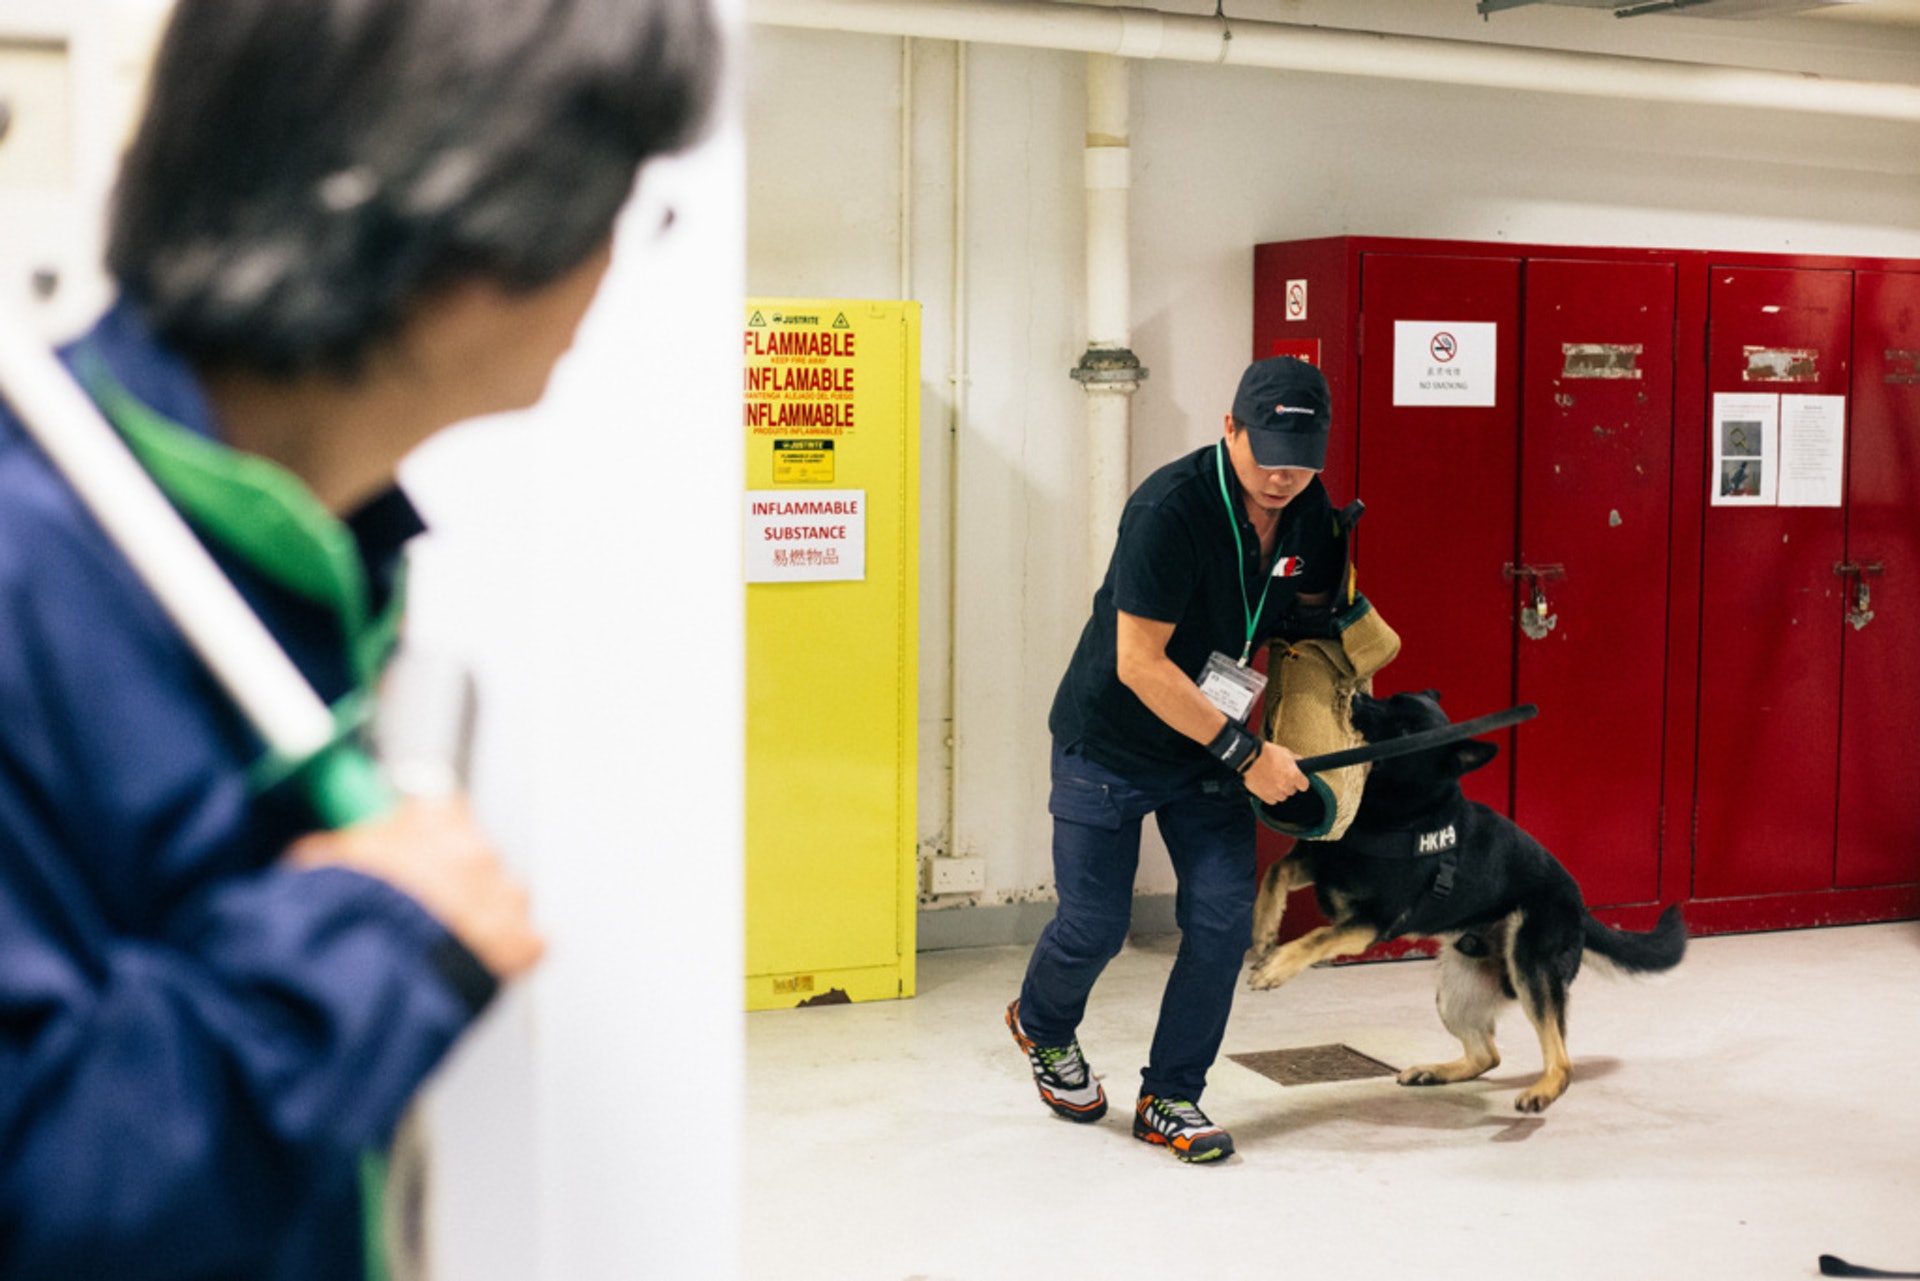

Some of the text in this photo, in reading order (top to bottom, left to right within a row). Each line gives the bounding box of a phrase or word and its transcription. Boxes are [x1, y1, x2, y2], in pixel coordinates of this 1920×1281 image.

[783, 315, 819, 325] JUSTRITE
[743, 331, 855, 356] FLAMMABLE
[1432, 382, 1468, 390] SMOKING
[752, 501, 857, 515] INFLAMMABLE
[764, 526, 846, 540] SUBSTANCE
[774, 549, 839, 566] 易燃物品
[1419, 832, 1439, 852] HK
